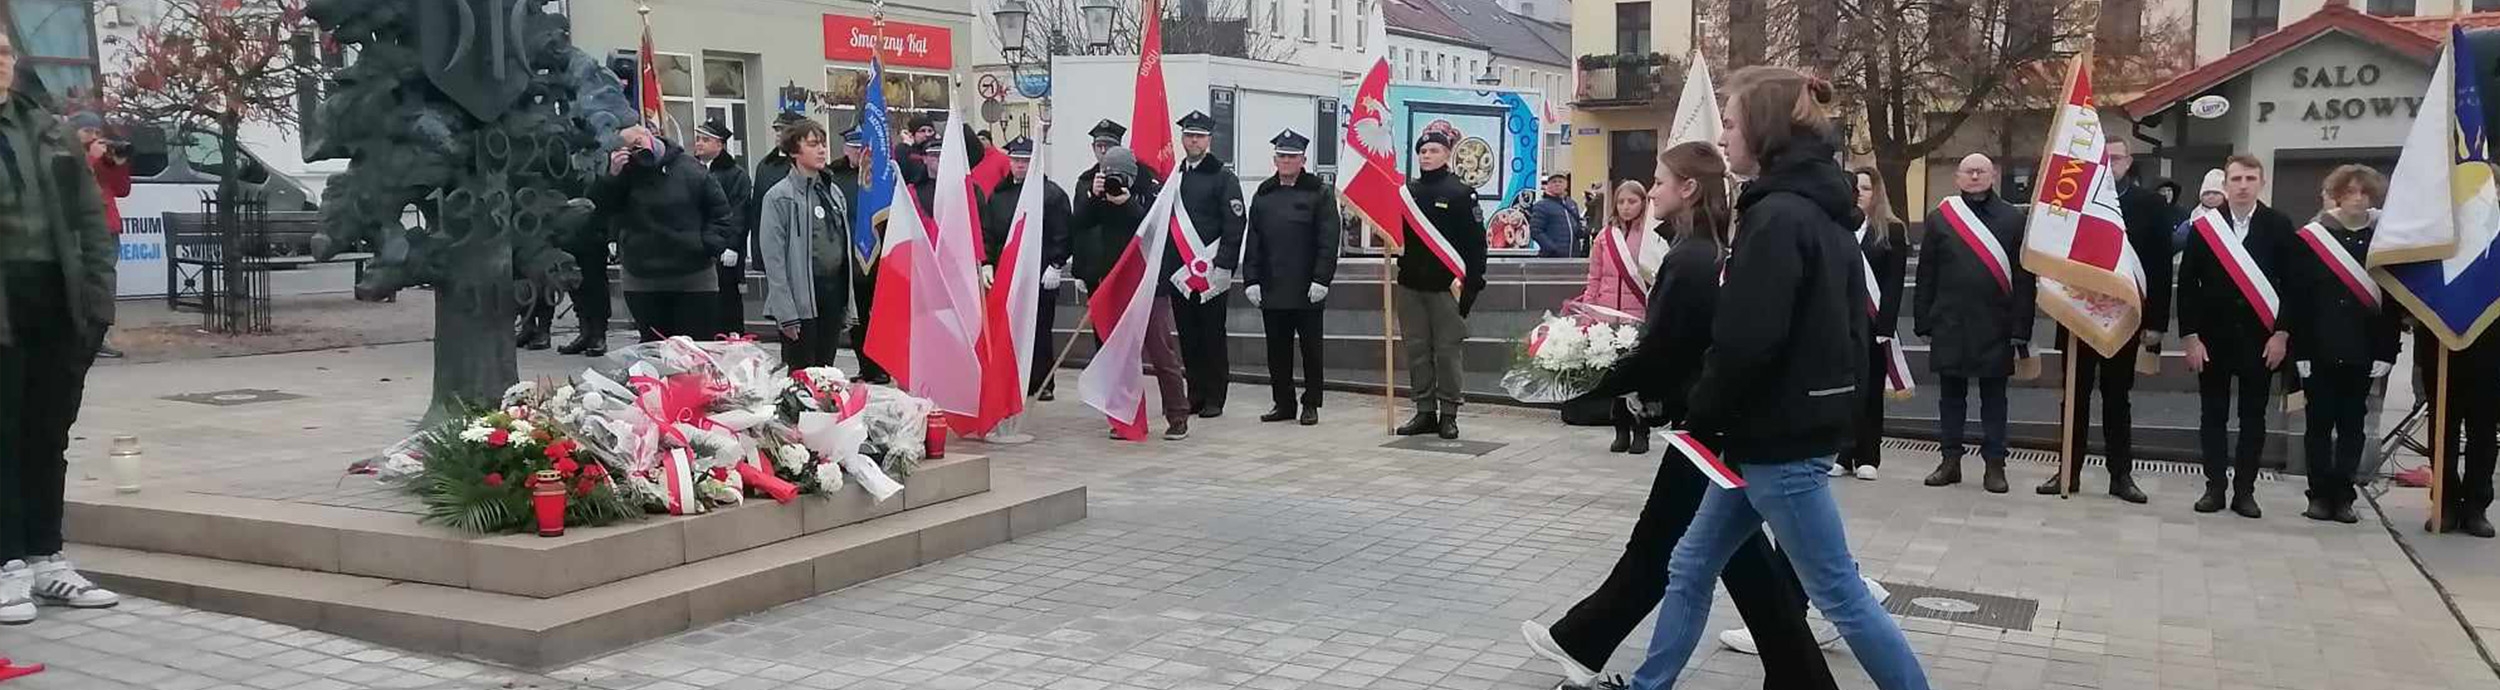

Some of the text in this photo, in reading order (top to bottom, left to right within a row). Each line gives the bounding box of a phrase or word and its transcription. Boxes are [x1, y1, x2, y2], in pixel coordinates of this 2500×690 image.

[850, 27, 903, 57] Smazny
[2292, 63, 2381, 89] SALO
[2320, 125, 2340, 141] 17
[474, 126, 570, 178] 1920
